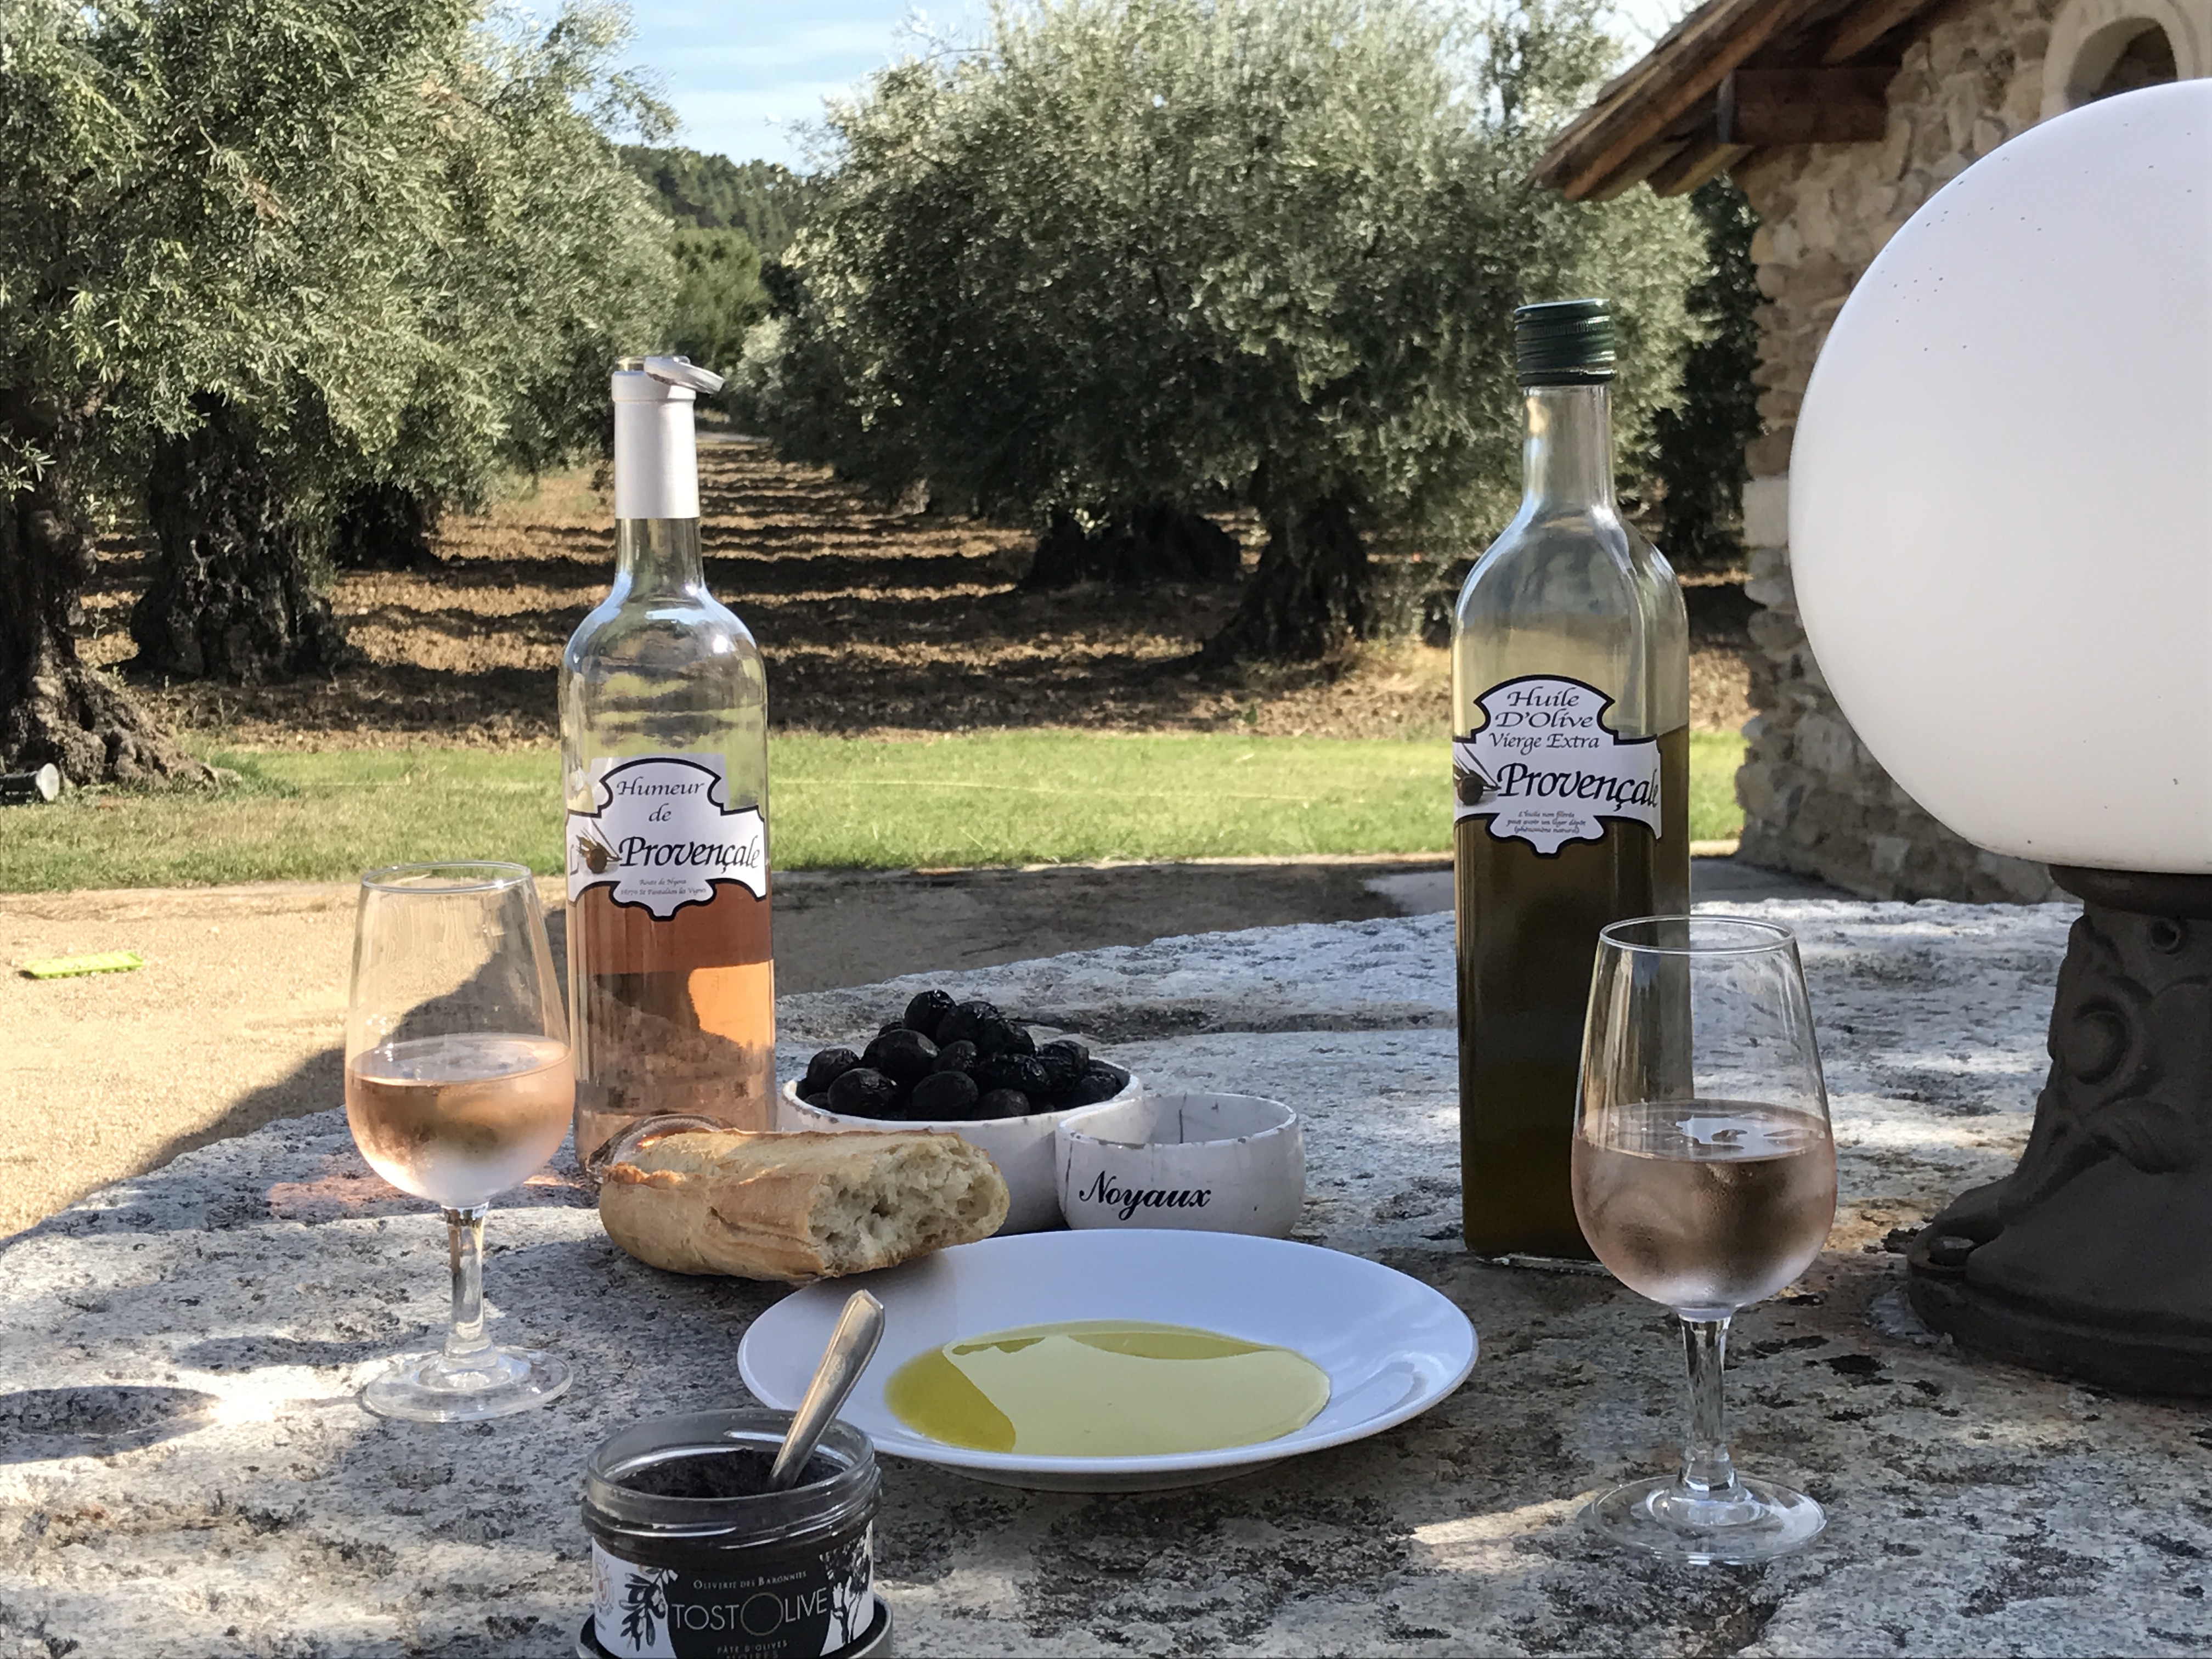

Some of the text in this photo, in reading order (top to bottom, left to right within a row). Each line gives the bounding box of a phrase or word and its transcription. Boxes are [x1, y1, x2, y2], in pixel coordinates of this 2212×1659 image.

[1507, 686, 1579, 707] Huile
[1495, 708, 1593, 727] D'Olive
[1489, 732, 1599, 755] Vierge Extra
[616, 776, 704, 796] Humeur
[1497, 763, 1658, 812] Provençale
[648, 803, 672, 822] de
[618, 835, 760, 874] Provençale
[1079, 1170, 1212, 1221] Noyaux
[672, 1587, 828, 1637] TOSTOLIVE
